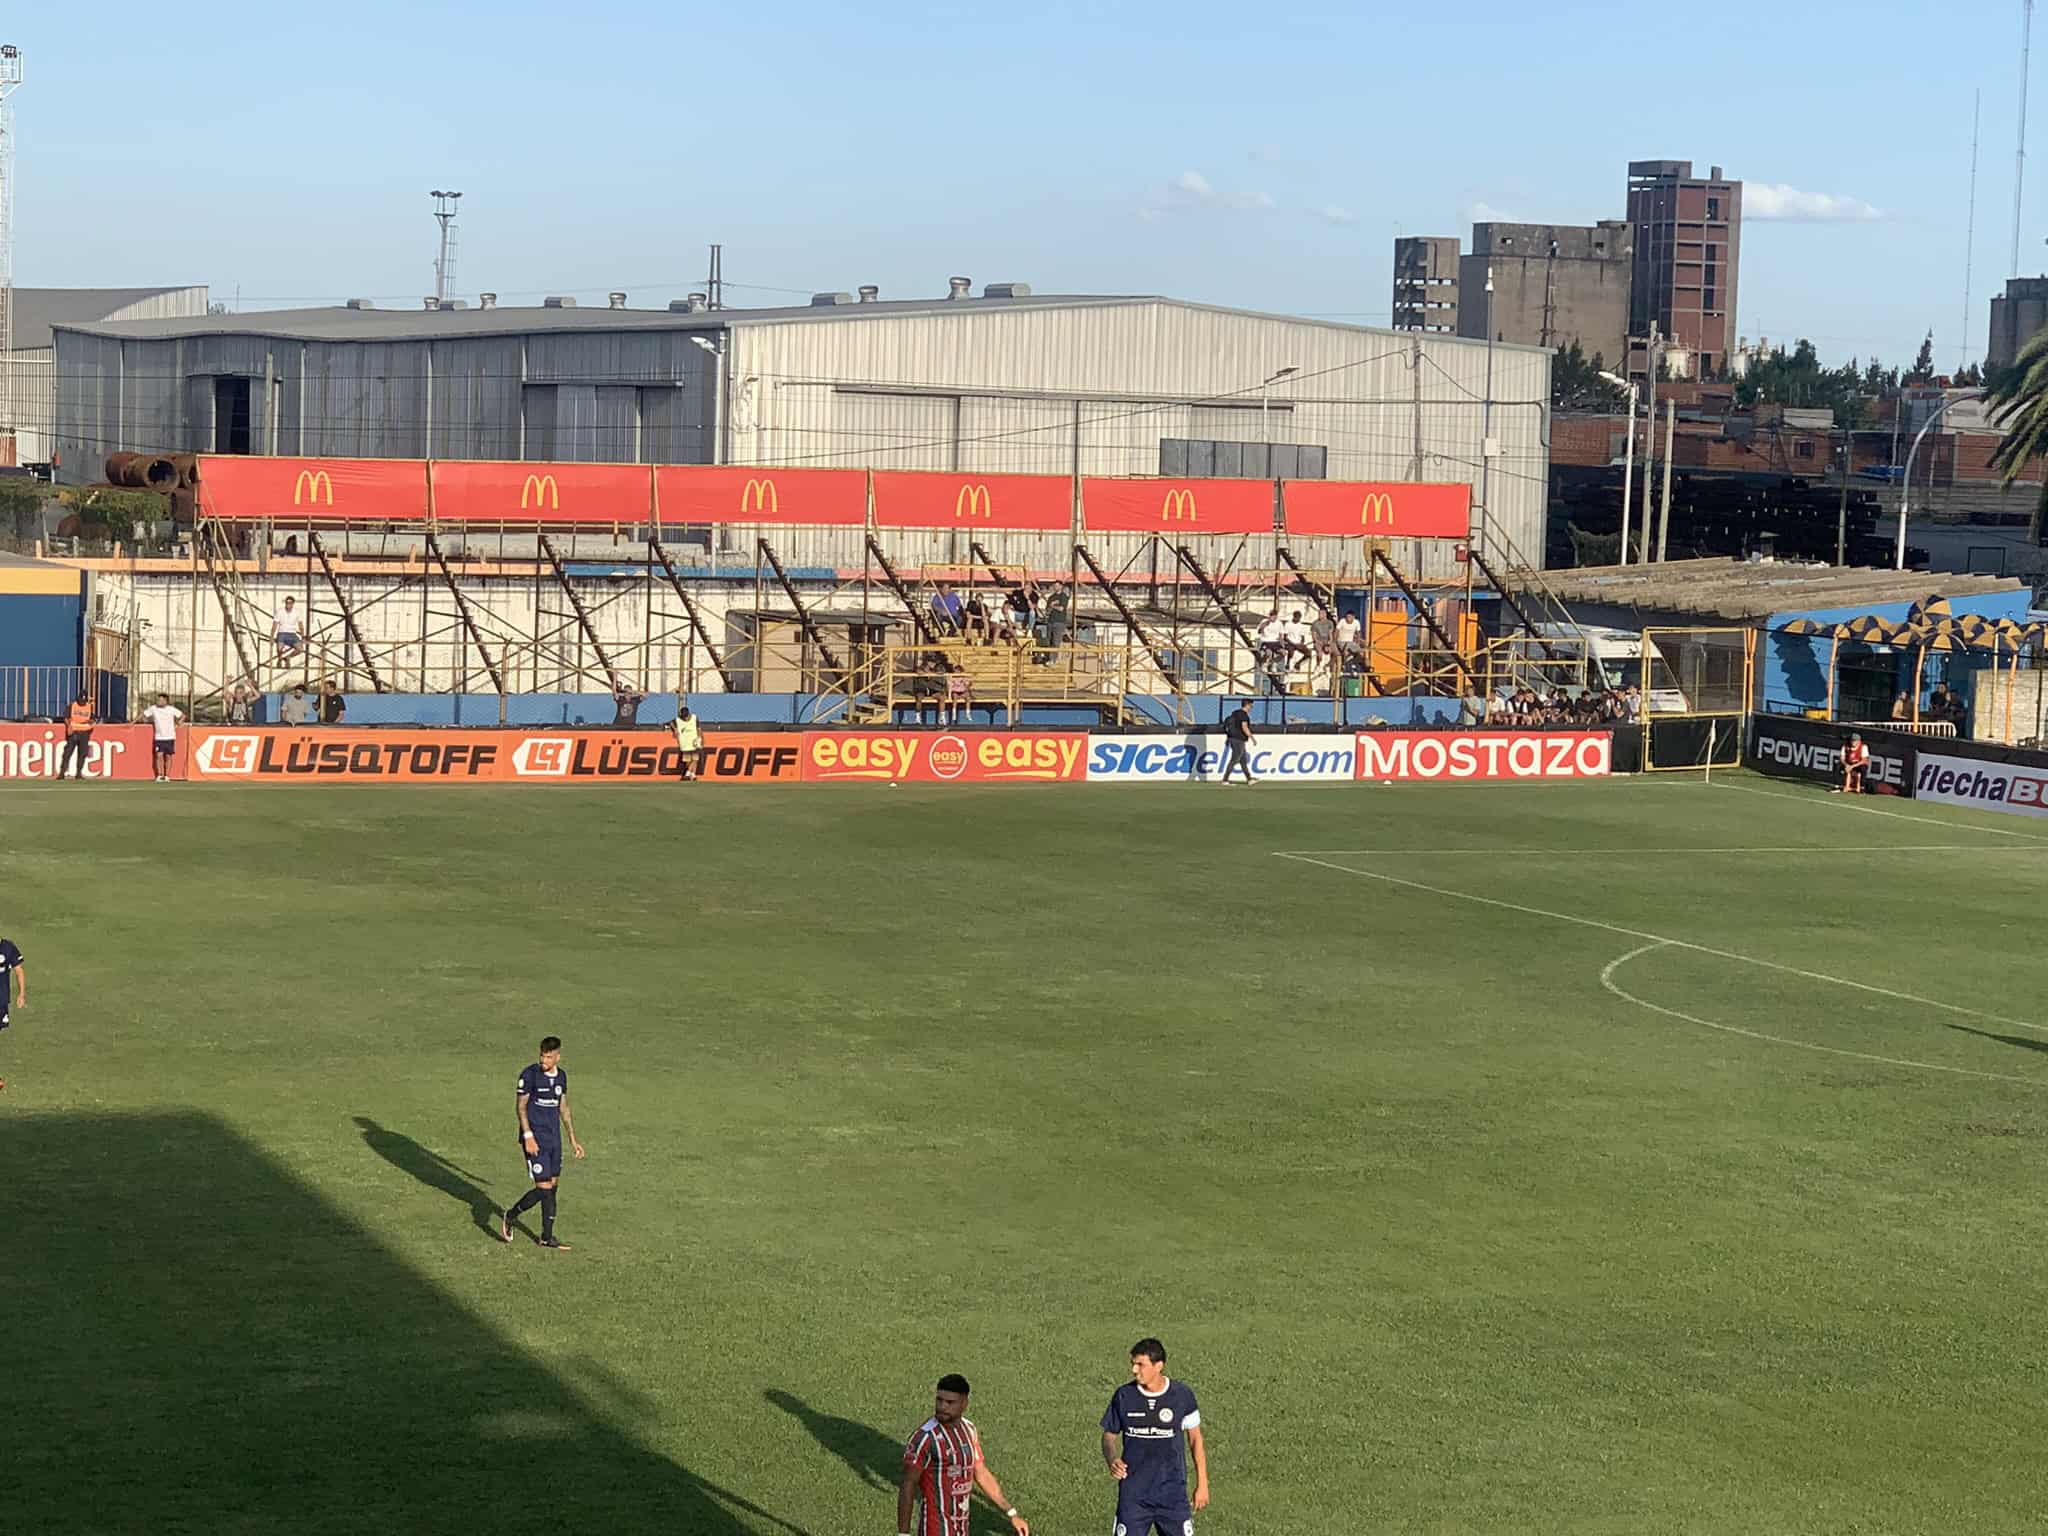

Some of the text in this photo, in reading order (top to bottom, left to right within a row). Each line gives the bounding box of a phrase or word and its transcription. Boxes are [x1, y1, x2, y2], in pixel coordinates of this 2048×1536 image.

[812, 737, 919, 778] easy
[933, 751, 964, 765] easy
[978, 738, 1082, 778] easy
[1757, 736, 1903, 785] POWERDE
